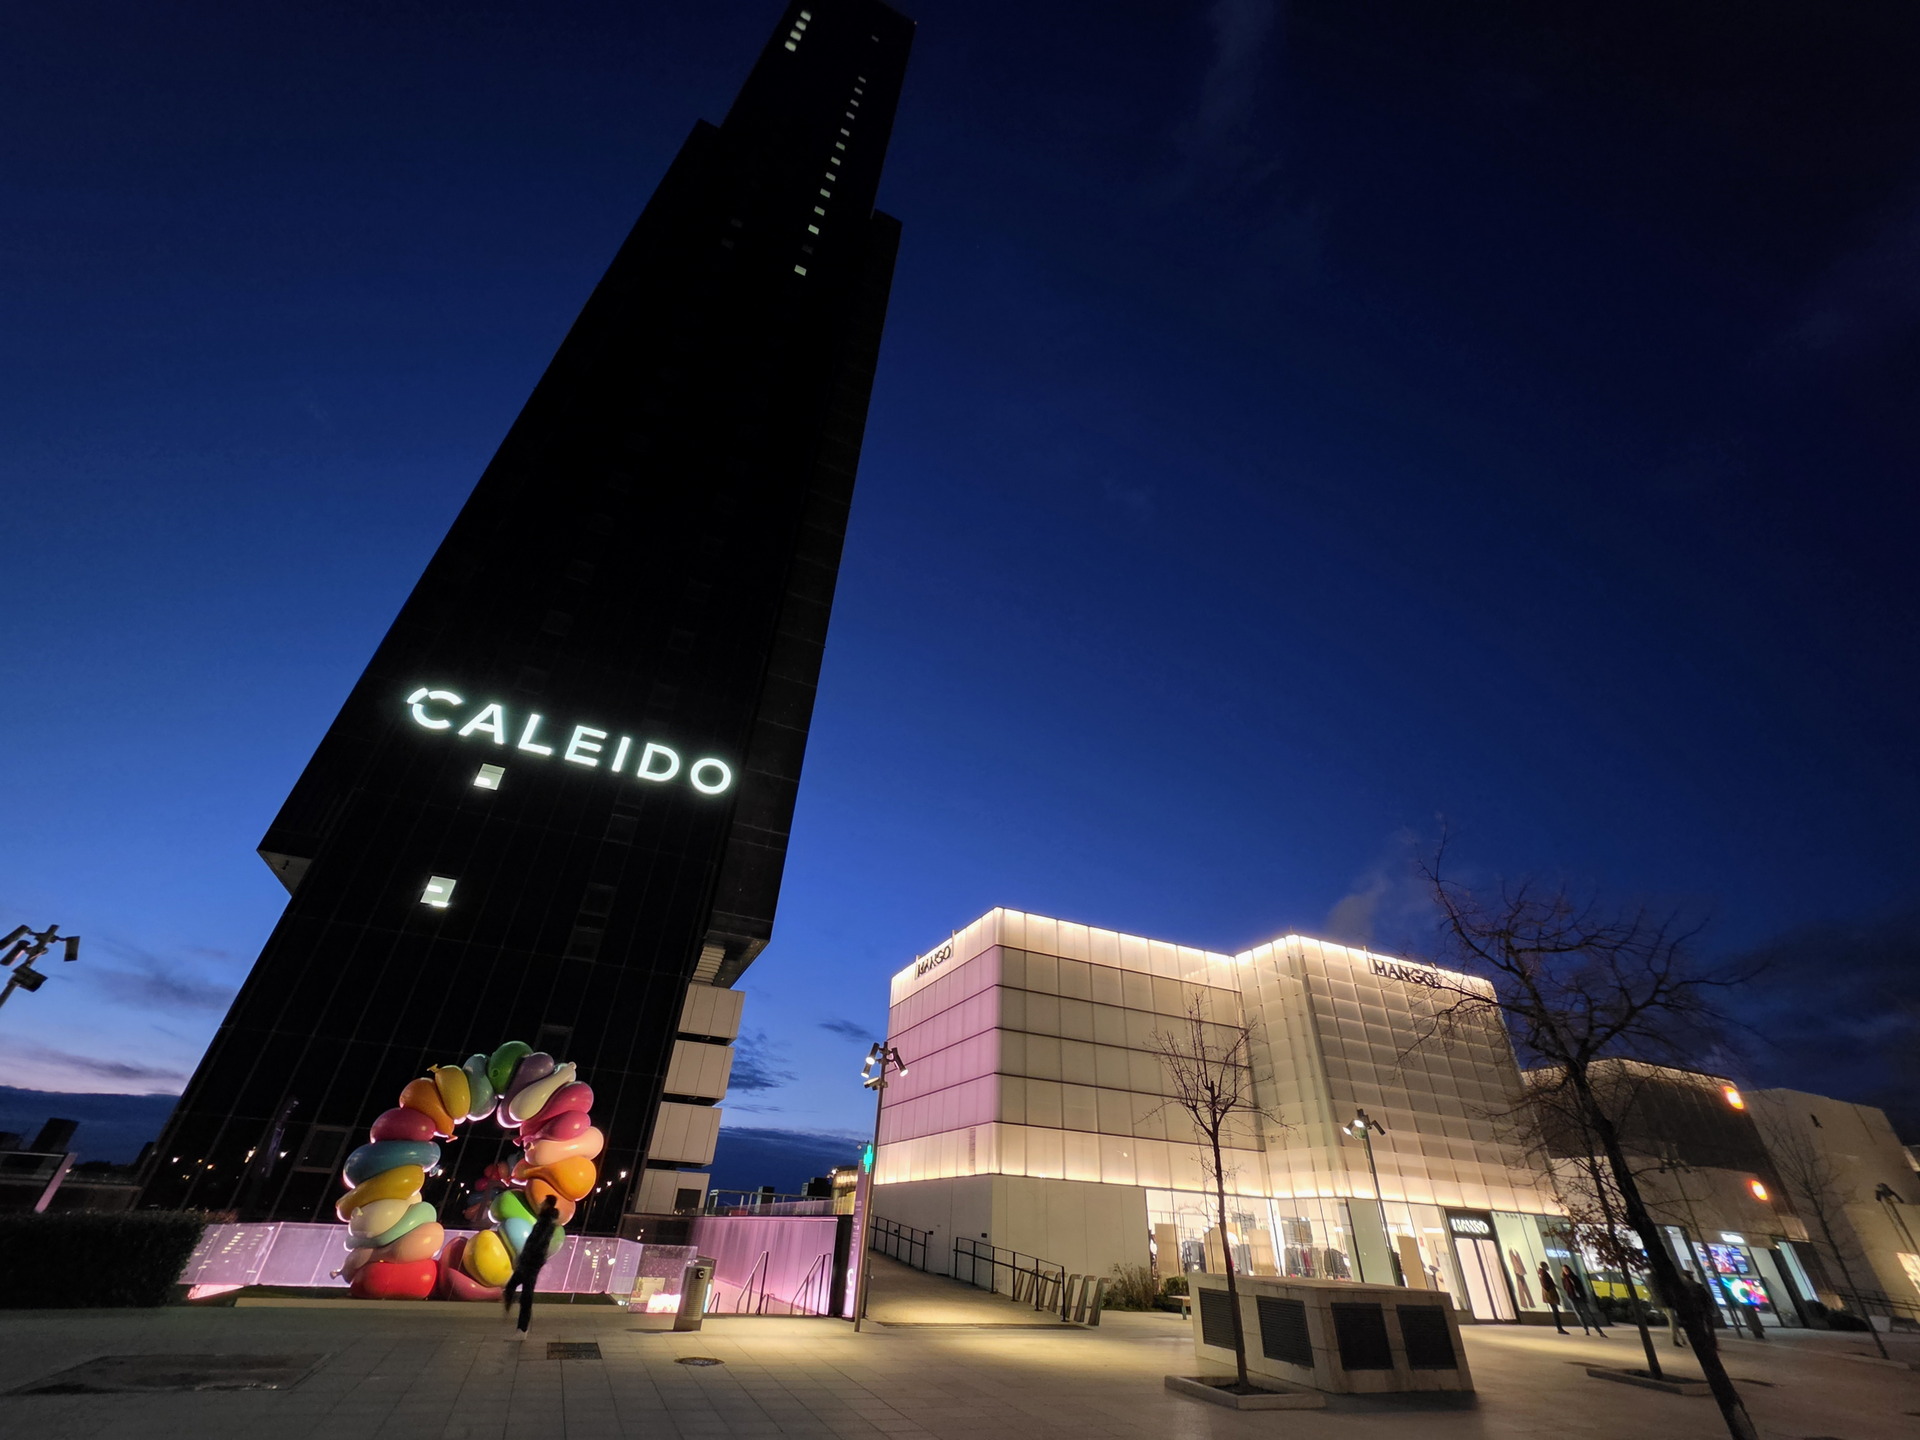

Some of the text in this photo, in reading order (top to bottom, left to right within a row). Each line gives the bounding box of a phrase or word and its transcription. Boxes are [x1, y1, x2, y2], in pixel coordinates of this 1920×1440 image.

[407, 687, 732, 795] CALEIDO
[917, 946, 951, 977] MANGO
[1373, 959, 1435, 987] MANGO
